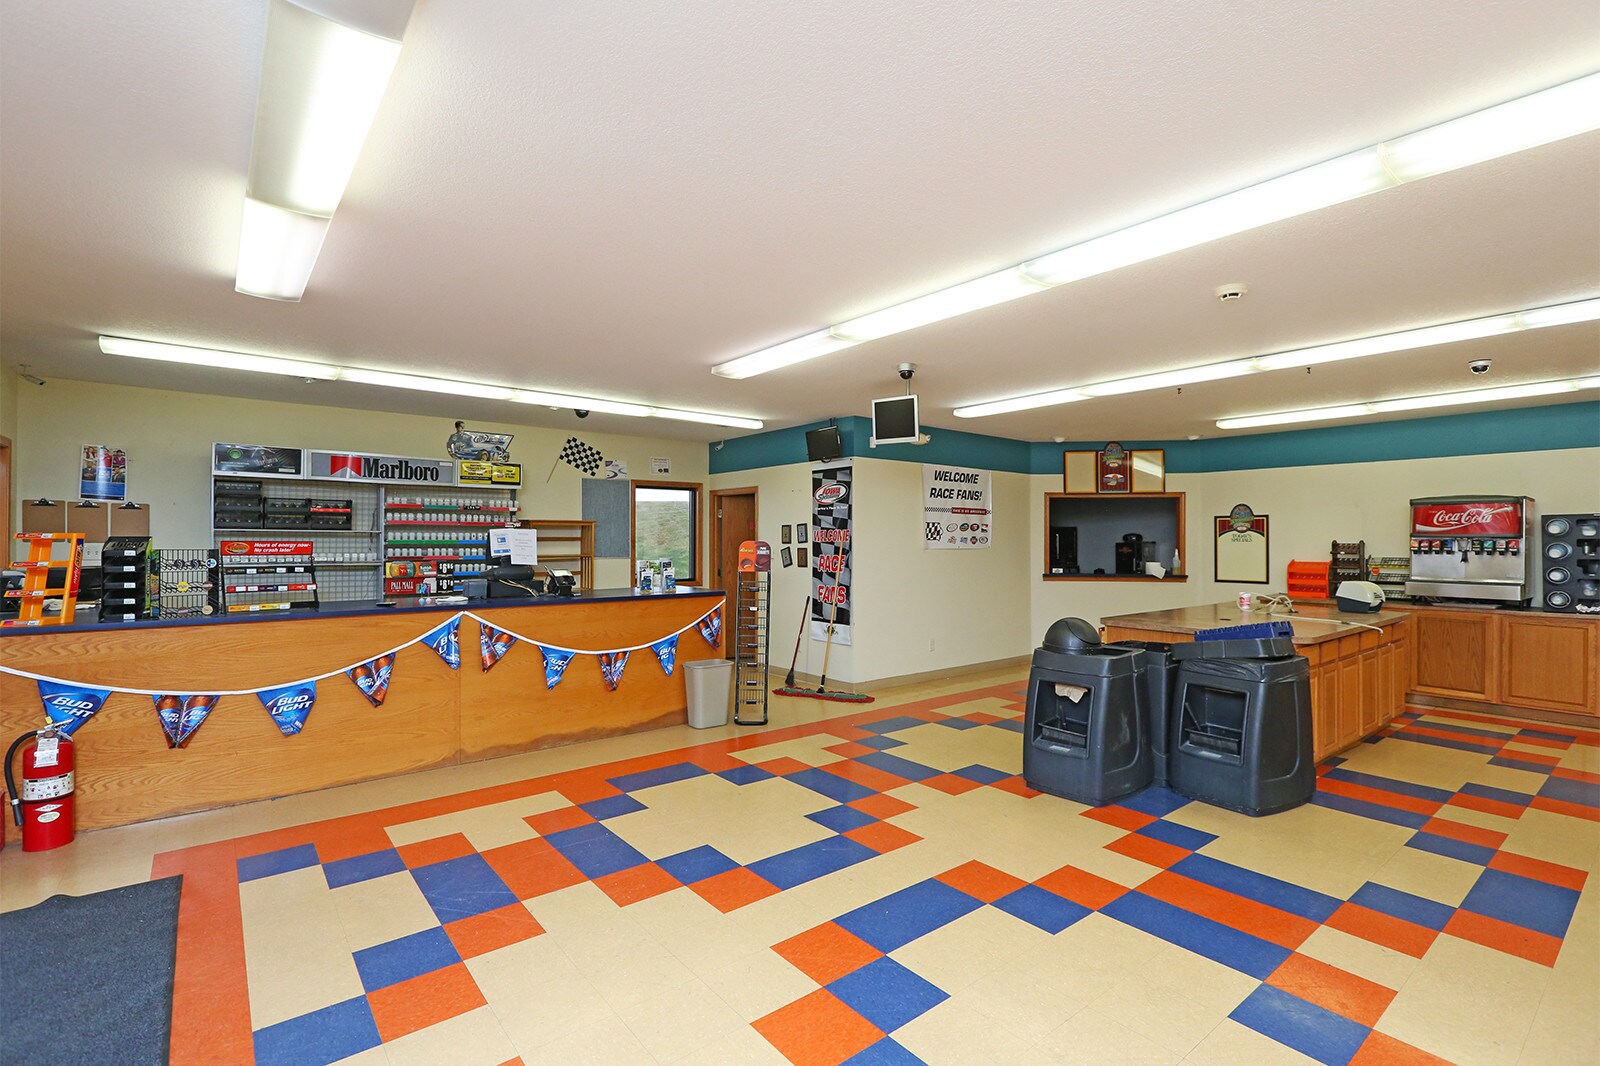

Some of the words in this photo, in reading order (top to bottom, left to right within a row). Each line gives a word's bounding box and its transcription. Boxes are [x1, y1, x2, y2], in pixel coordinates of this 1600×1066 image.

[362, 457, 440, 481] Marlboro
[934, 470, 979, 484] WELCOME
[929, 487, 955, 499] RACE
[956, 489, 983, 501] FANS!
[1433, 507, 1493, 526] Coca-Cola
[813, 529, 850, 543] WELCOME
[817, 555, 847, 573] RACE
[817, 585, 847, 604] FANS
[51, 696, 94, 709] BUD
[272, 700, 313, 715] LIGHT
[277, 694, 309, 707] BUD
